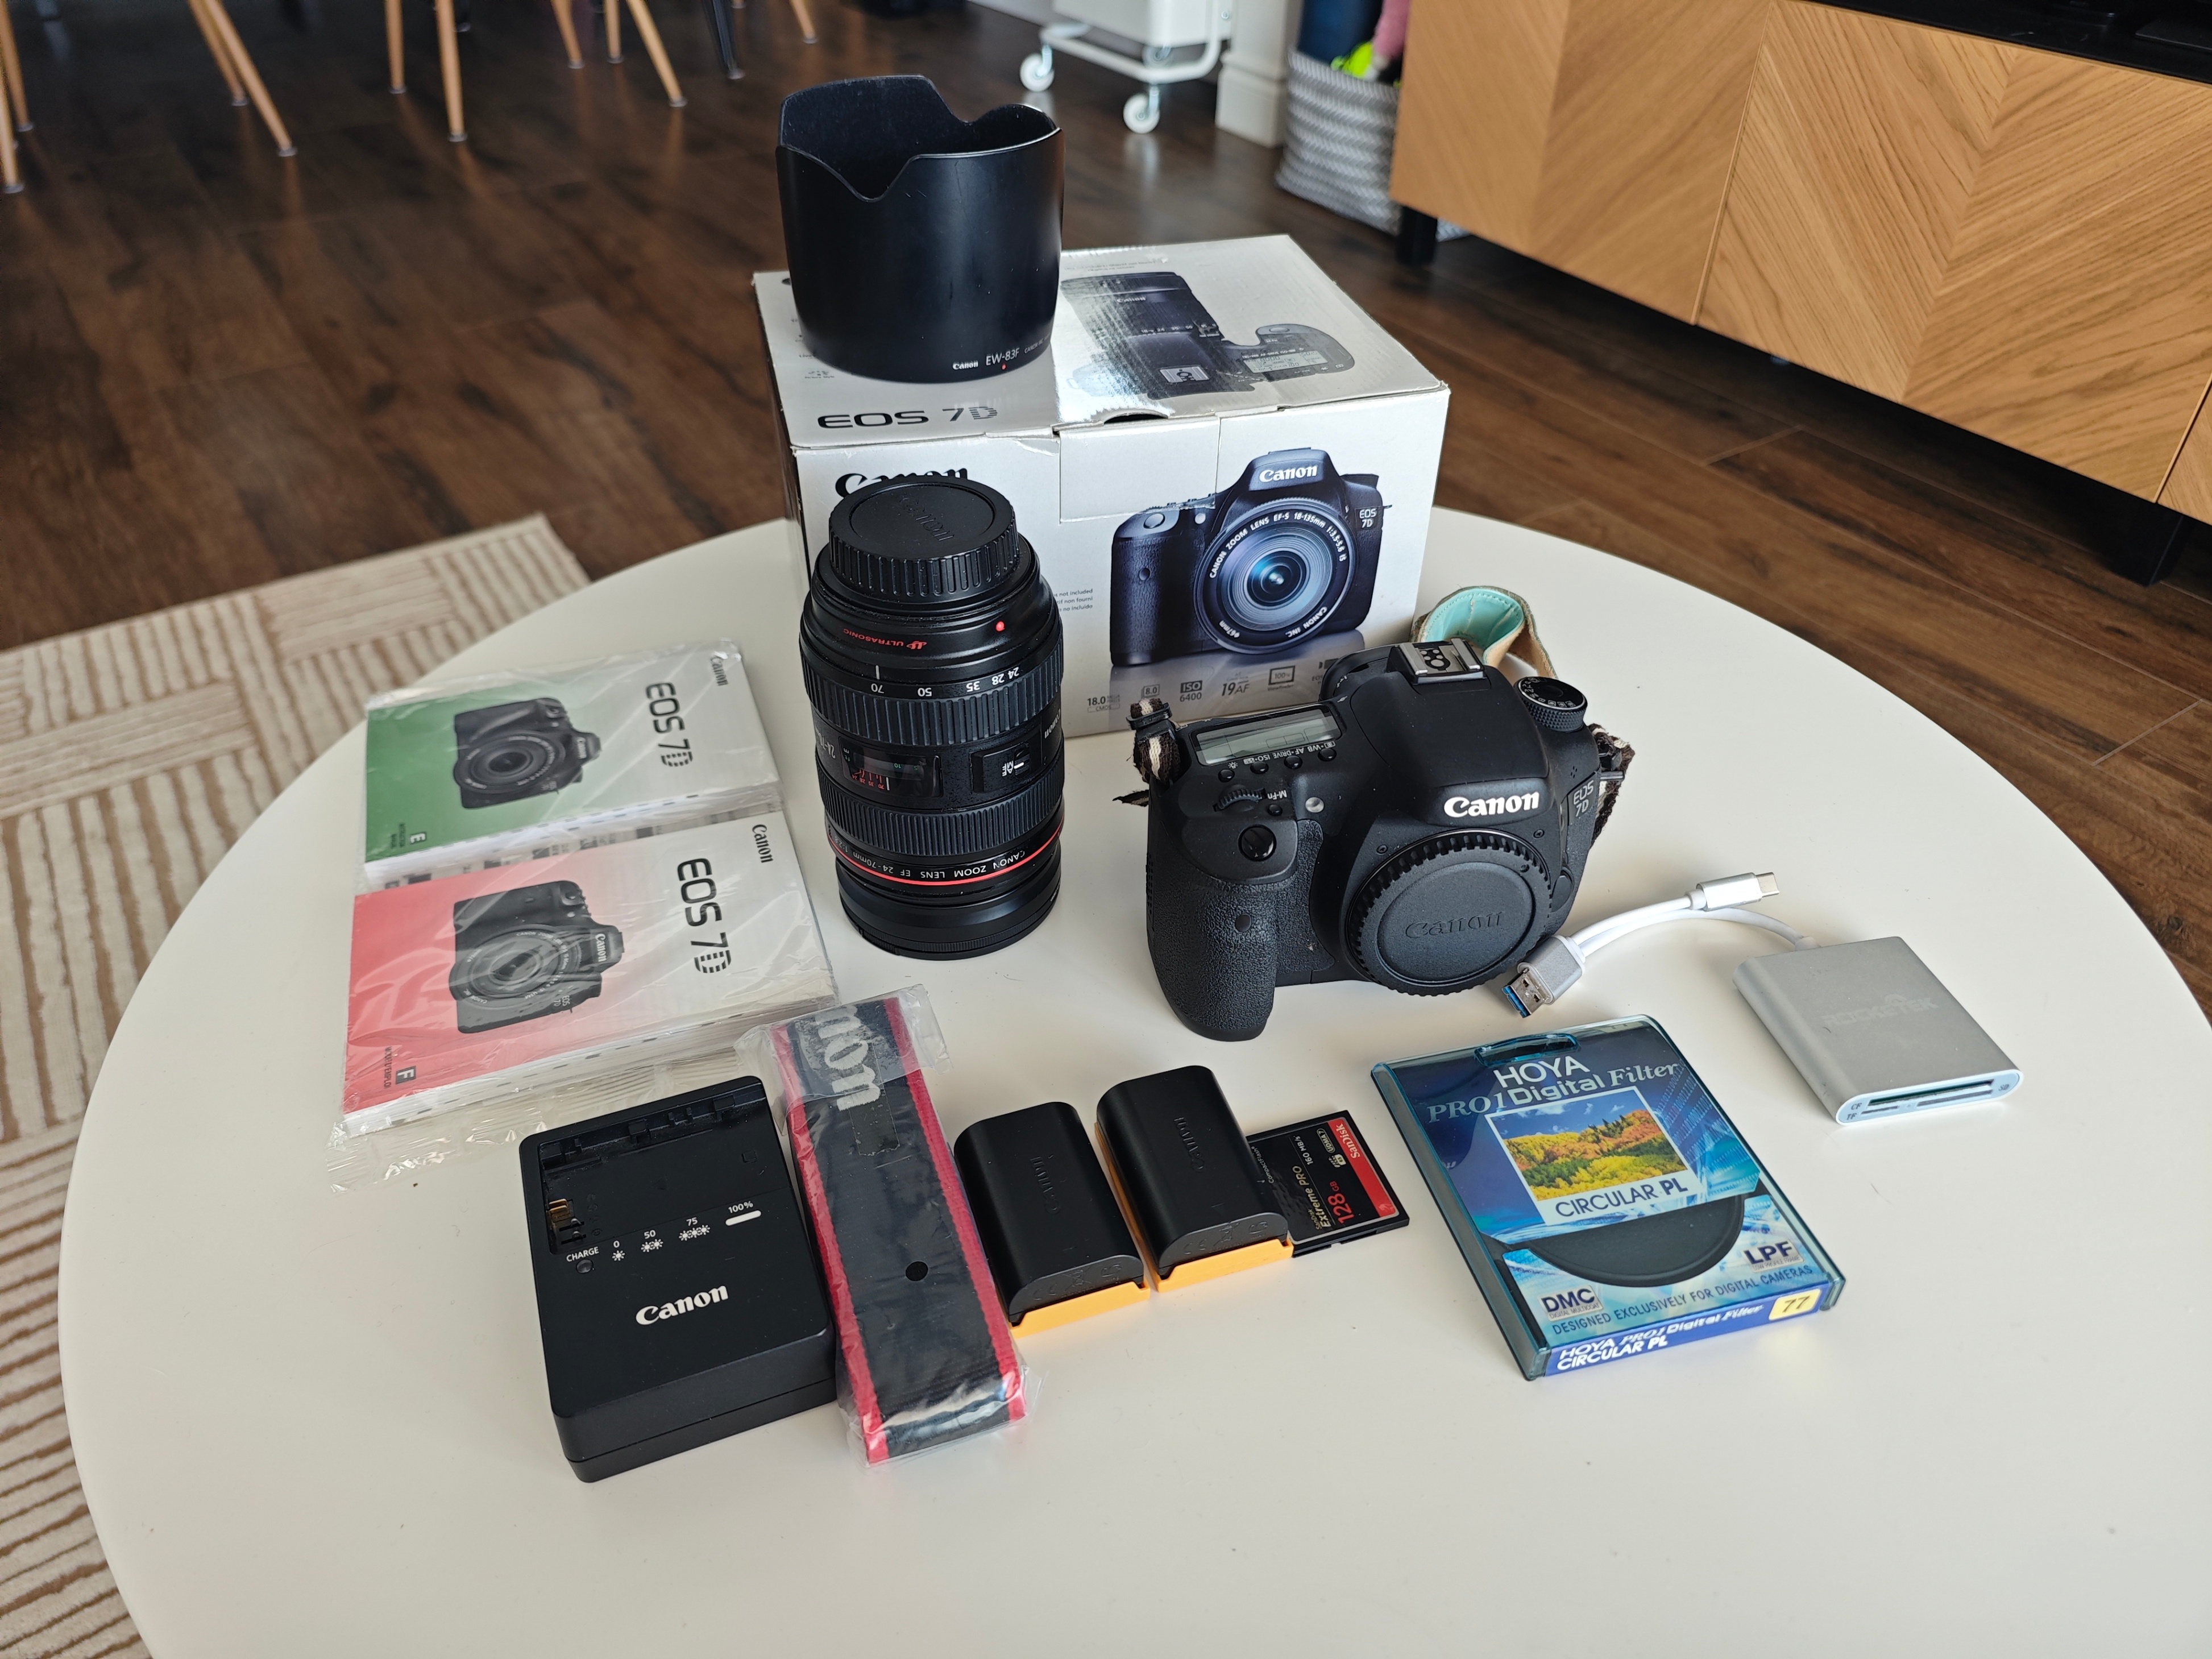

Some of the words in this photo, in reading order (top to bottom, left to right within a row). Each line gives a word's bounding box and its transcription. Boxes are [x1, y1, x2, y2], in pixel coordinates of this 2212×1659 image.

[952, 360, 979, 370] Canon
[985, 347, 1020, 366] EW-83F
[817, 410, 929, 429] EOS
[942, 406, 998, 422] 7D
[1259, 464, 1318, 483] Canon
[1359, 508, 1377, 519] EOS
[1361, 517, 1374, 528] 7D
[1209, 550, 1227, 579] CANON
[1225, 528, 1248, 550] ZOOM
[1250, 516, 1270, 532] LENS
[1273, 511, 1290, 522] EF-S
[1293, 511, 1326, 529] 18-135mm
[1338, 553, 1347, 562] IS
[1302, 605, 1328, 629] CANON
[843, 628, 904, 647] ULTRASONIC
[1285, 627, 1302, 638] INC.
[871, 683, 885, 694] 70
[918, 687, 932, 697] 50
[966, 681, 980, 692] 35
[991, 677, 1005, 686] 28
[1008, 666, 1019, 679] 24
[1182, 682, 1201, 691] ISO
[1222, 682, 1235, 696] 19
[1234, 683, 1250, 694] AF
[645, 682, 685, 734] EOS
[1087, 696, 1106, 706] 18.0
[1180, 692, 1202, 702] 6400
[658, 739, 694, 767] 7D
[1267, 790, 1288, 801] M-Fn
[1574, 780, 1594, 804] EOS
[1444, 791, 1539, 818] Canon
[1575, 799, 1589, 817] 7D
[410, 832, 426, 844] E
[752, 824, 774, 863] Canon
[853, 851, 894, 874] 24-70mm
[954, 865, 986, 878] ZOOM
[993, 851, 1025, 869] CANON
[677, 858, 723, 927] EOS
[1405, 911, 1504, 939] Canon
[595, 934, 608, 962] Canon
[690, 932, 732, 974] 7D
[397, 1069, 414, 1079] F
[1493, 1056, 1590, 1088] HOYA
[1507, 1074, 1605, 1105] Digital
[1608, 1063, 1679, 1087] Filter
[1336, 1123, 1360, 1159] SanDisk
[1302, 1152, 1314, 1166] 160
[1292, 1166, 1310, 1186] PRO
[1329, 1181, 1340, 1192] GB
[1305, 1188, 1332, 1228] Extreme
[1327, 1193, 1355, 1224] 128
[1555, 1184, 1655, 1217] CIRCULAR
[1659, 1177, 1688, 1196] PL
[1308, 1209, 1322, 1230] SanDisk
[566, 1247, 599, 1263] CHARGE
[644, 1230, 656, 1239] 50
[728, 1201, 753, 1213] 100%
[1743, 1241, 1793, 1265] LPF
[636, 1285, 729, 1325] Canon
[1541, 1288, 1595, 1313] DMC
[1552, 1312, 1612, 1335] DESIGNED
[1613, 1295, 1687, 1321] EXCLUSIVELY
[1690, 1288, 1713, 1303] FOR
[1715, 1278, 1758, 1296] DIGITAL
[1759, 1265, 1813, 1285] CAMERAS
[1782, 1296, 1811, 1313] 77
[1549, 1307, 1570, 1320] DIGITAL
[1559, 1338, 1616, 1361] HOYA
[1666, 1313, 1720, 1334] Digital
[1720, 1305, 1764, 1321] Filter
[1557, 1341, 1645, 1371] CIRCULAR
[1647, 1334, 1669, 1350] PL
